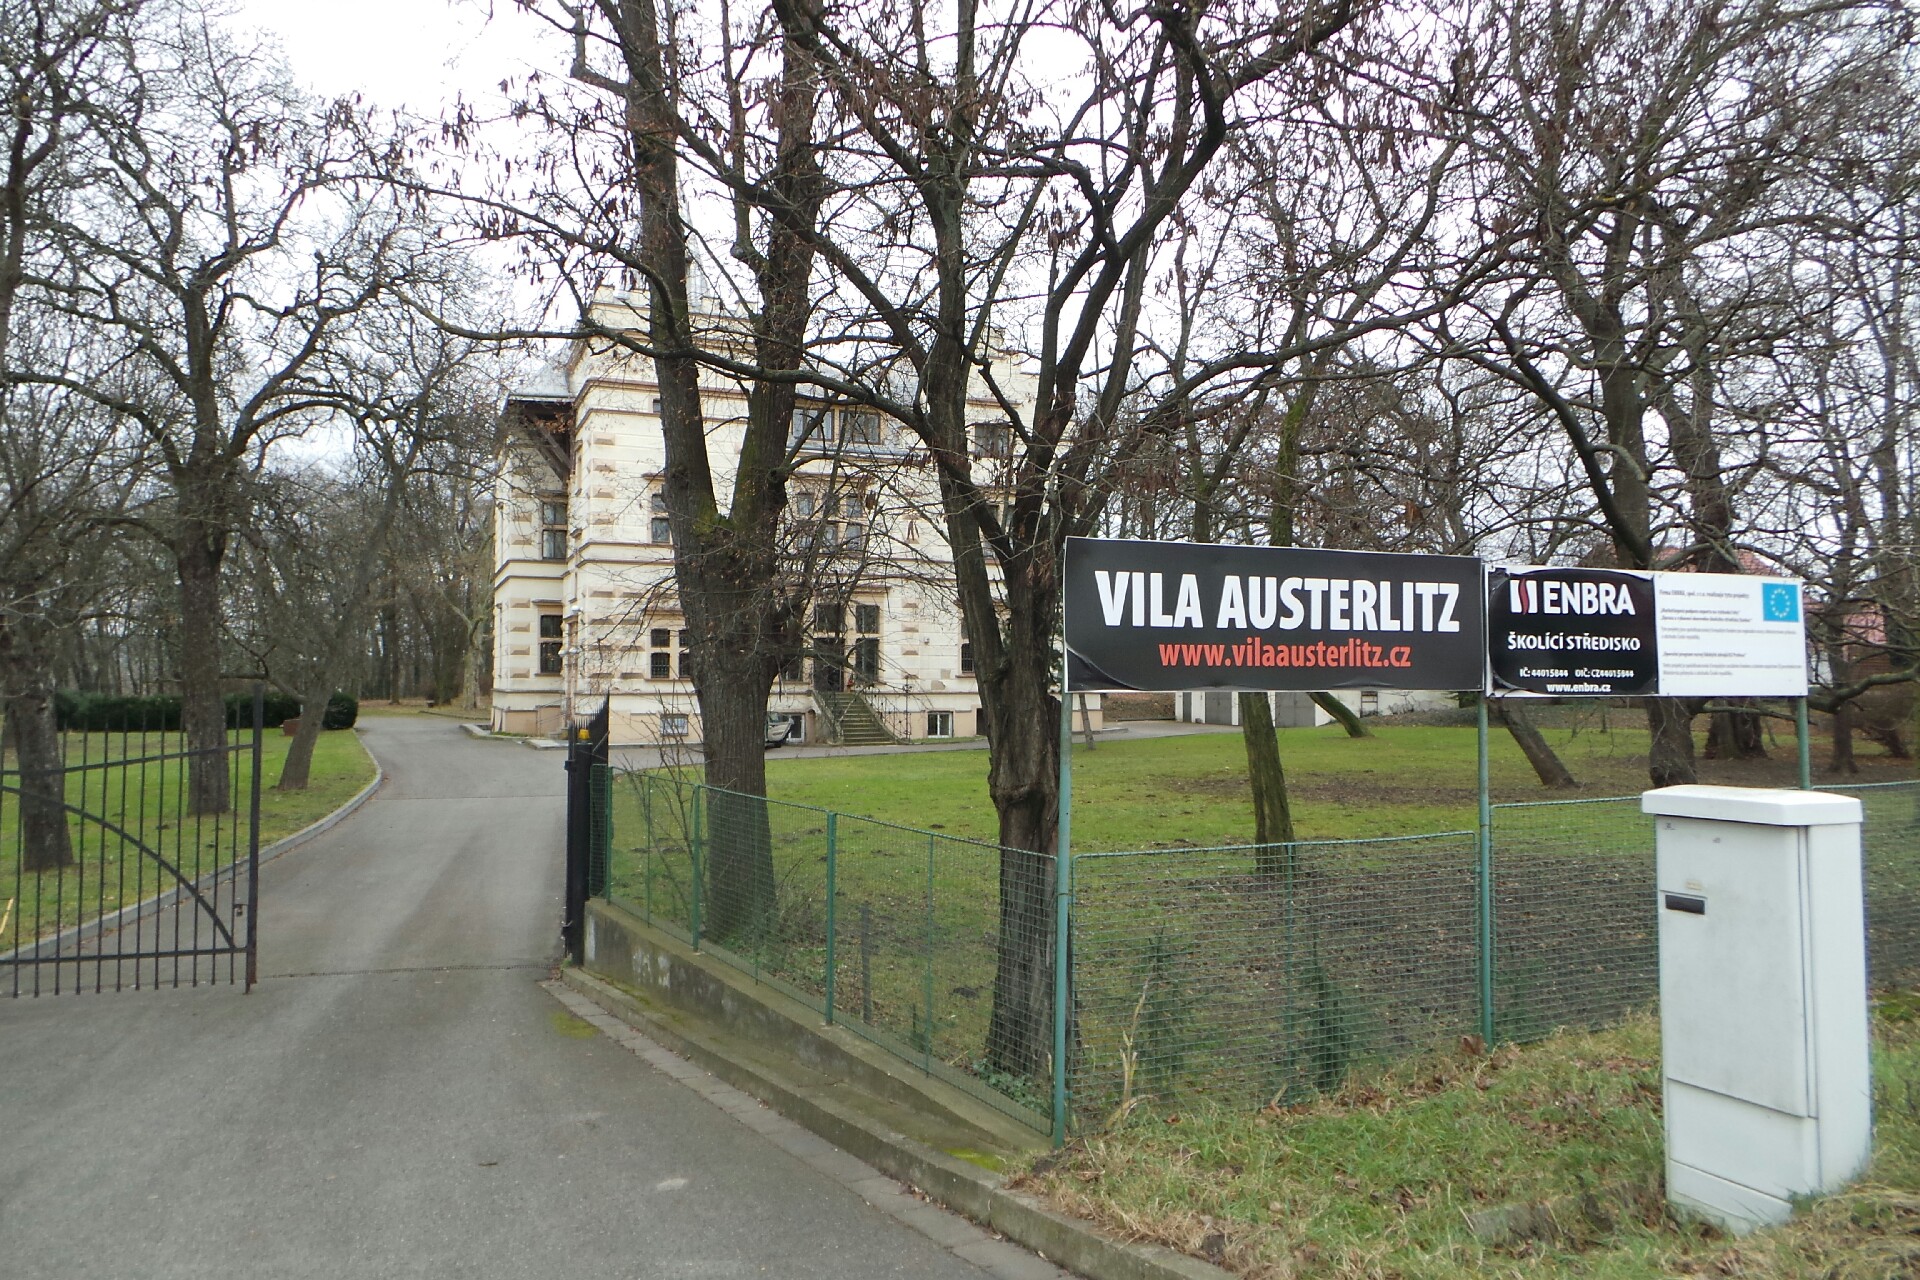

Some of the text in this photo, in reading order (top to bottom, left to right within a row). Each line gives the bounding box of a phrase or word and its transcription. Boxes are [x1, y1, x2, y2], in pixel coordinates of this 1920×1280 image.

[1094, 570, 1460, 633] VILA AUSTERLITZ
[1543, 580, 1636, 616] ENBRA
[1158, 637, 1412, 668] www.vilaausterlitz.cz
[1507, 631, 1641, 651] ŠKOLÍCÍ STŘEDISKO
[1546, 682, 1612, 693] www.enbra.cz
